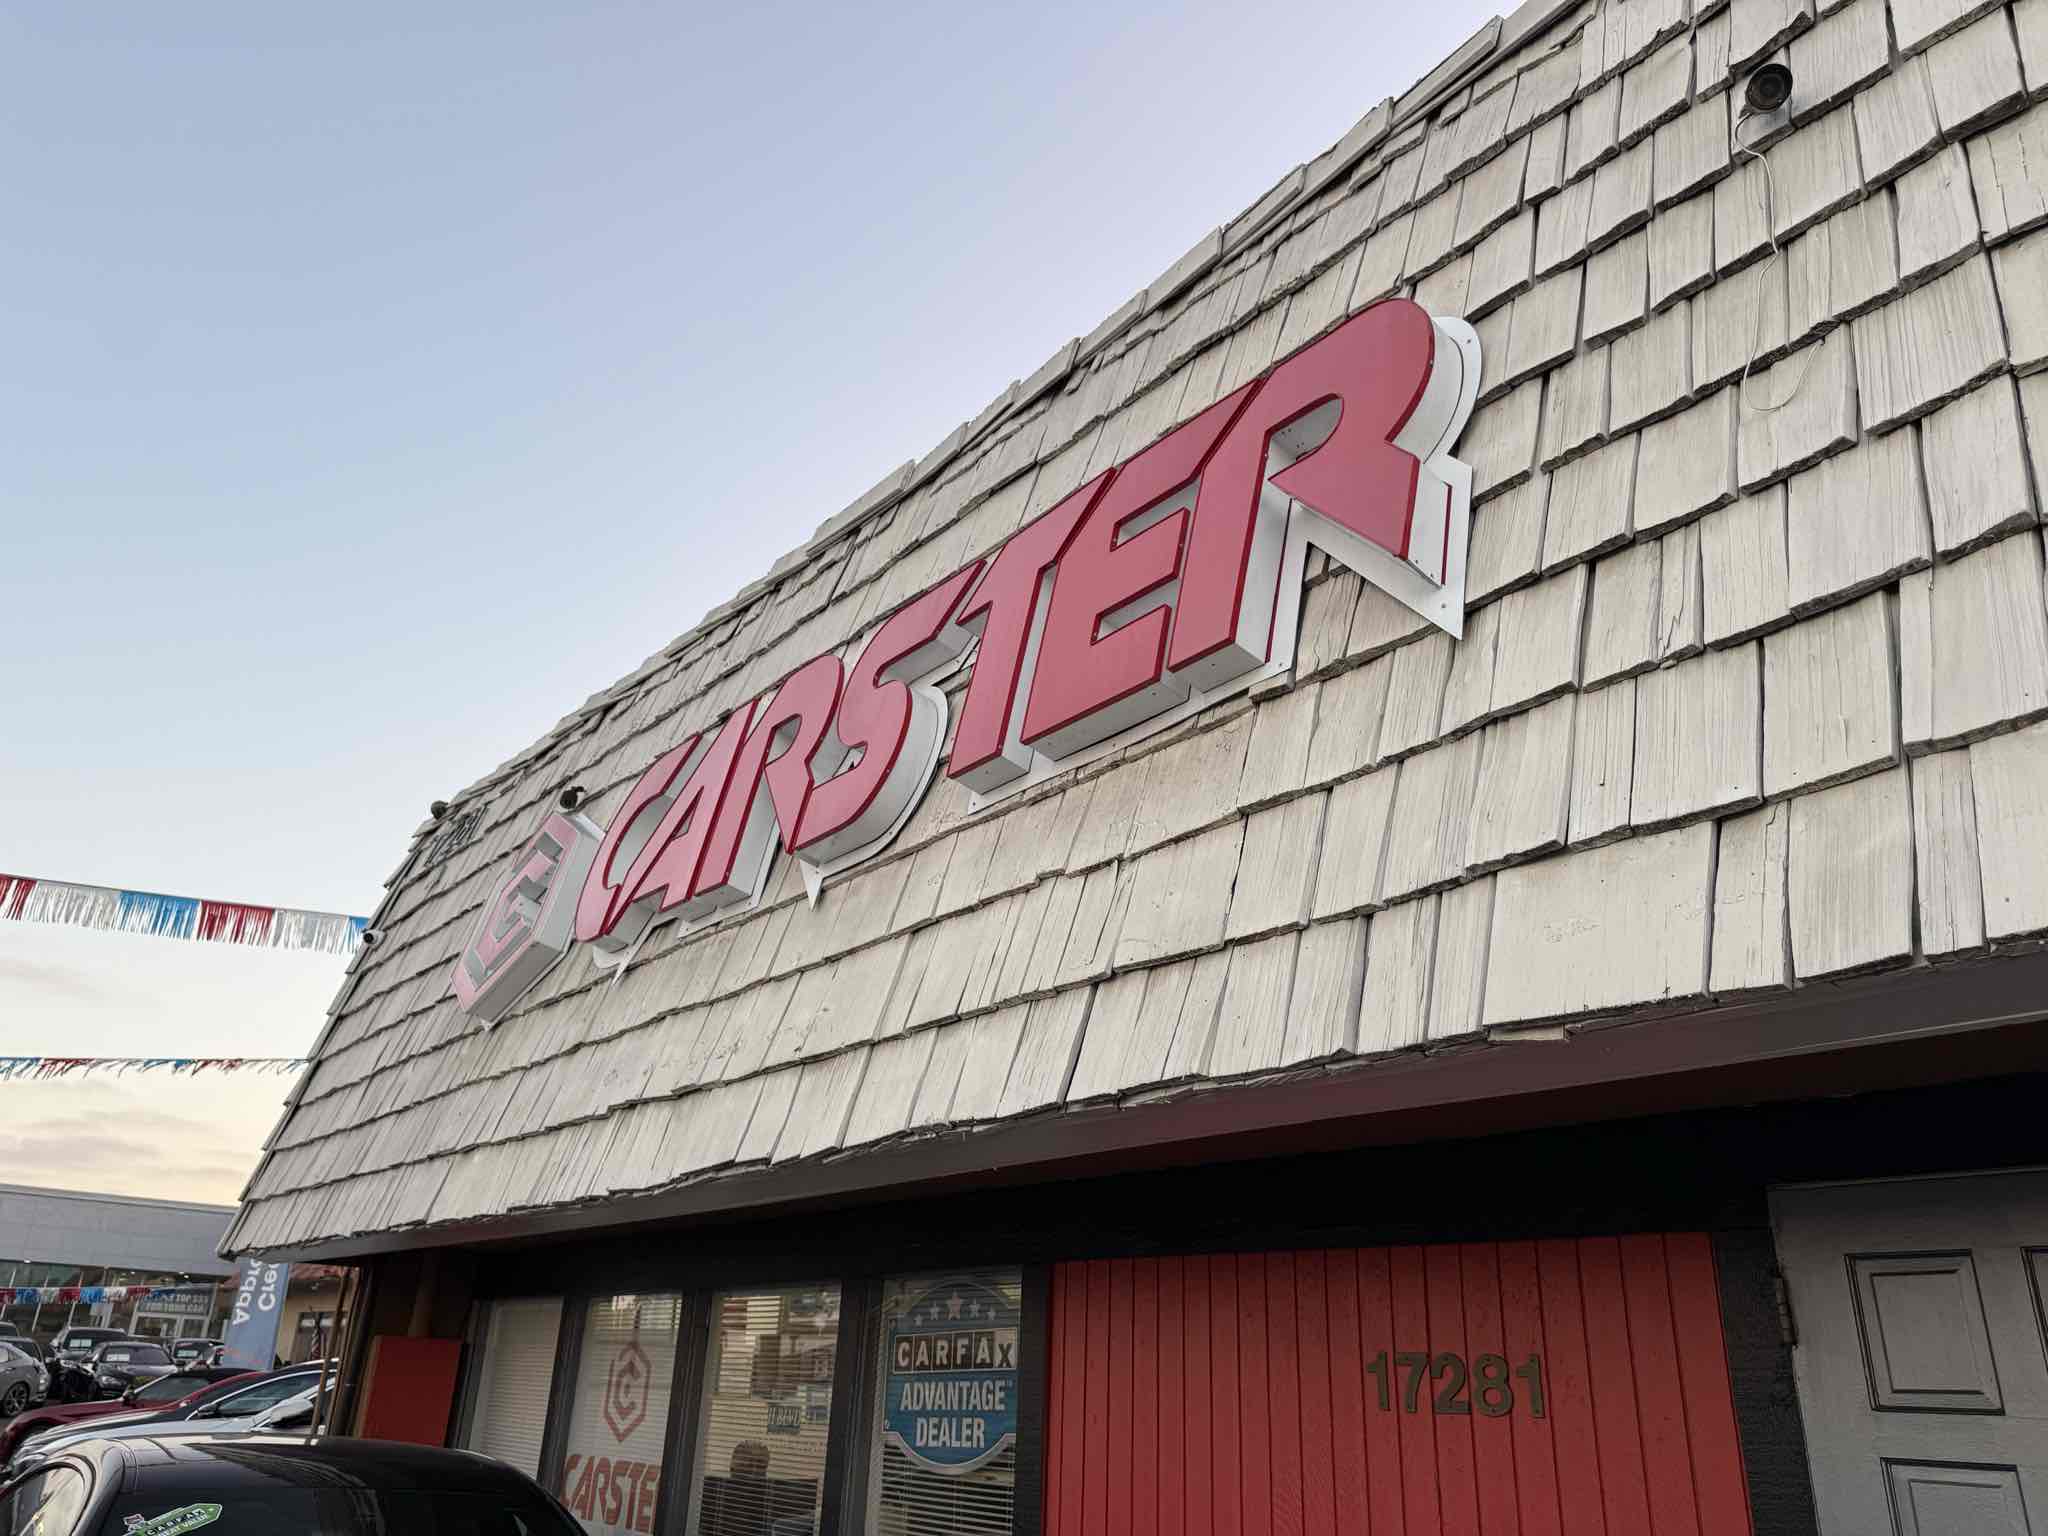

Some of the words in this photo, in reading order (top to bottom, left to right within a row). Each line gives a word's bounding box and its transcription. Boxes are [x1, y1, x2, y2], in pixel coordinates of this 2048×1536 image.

[575, 298, 1436, 941] CARSTER
[897, 1335, 1014, 1369] CARFAX
[900, 1379, 1006, 1412] ADVANTAGE
[1367, 1351, 1545, 1418] 17281
[915, 1416, 985, 1448] DEALER
[560, 1454, 661, 1533] CARSTE
[146, 1508, 206, 1535] CARFAX
